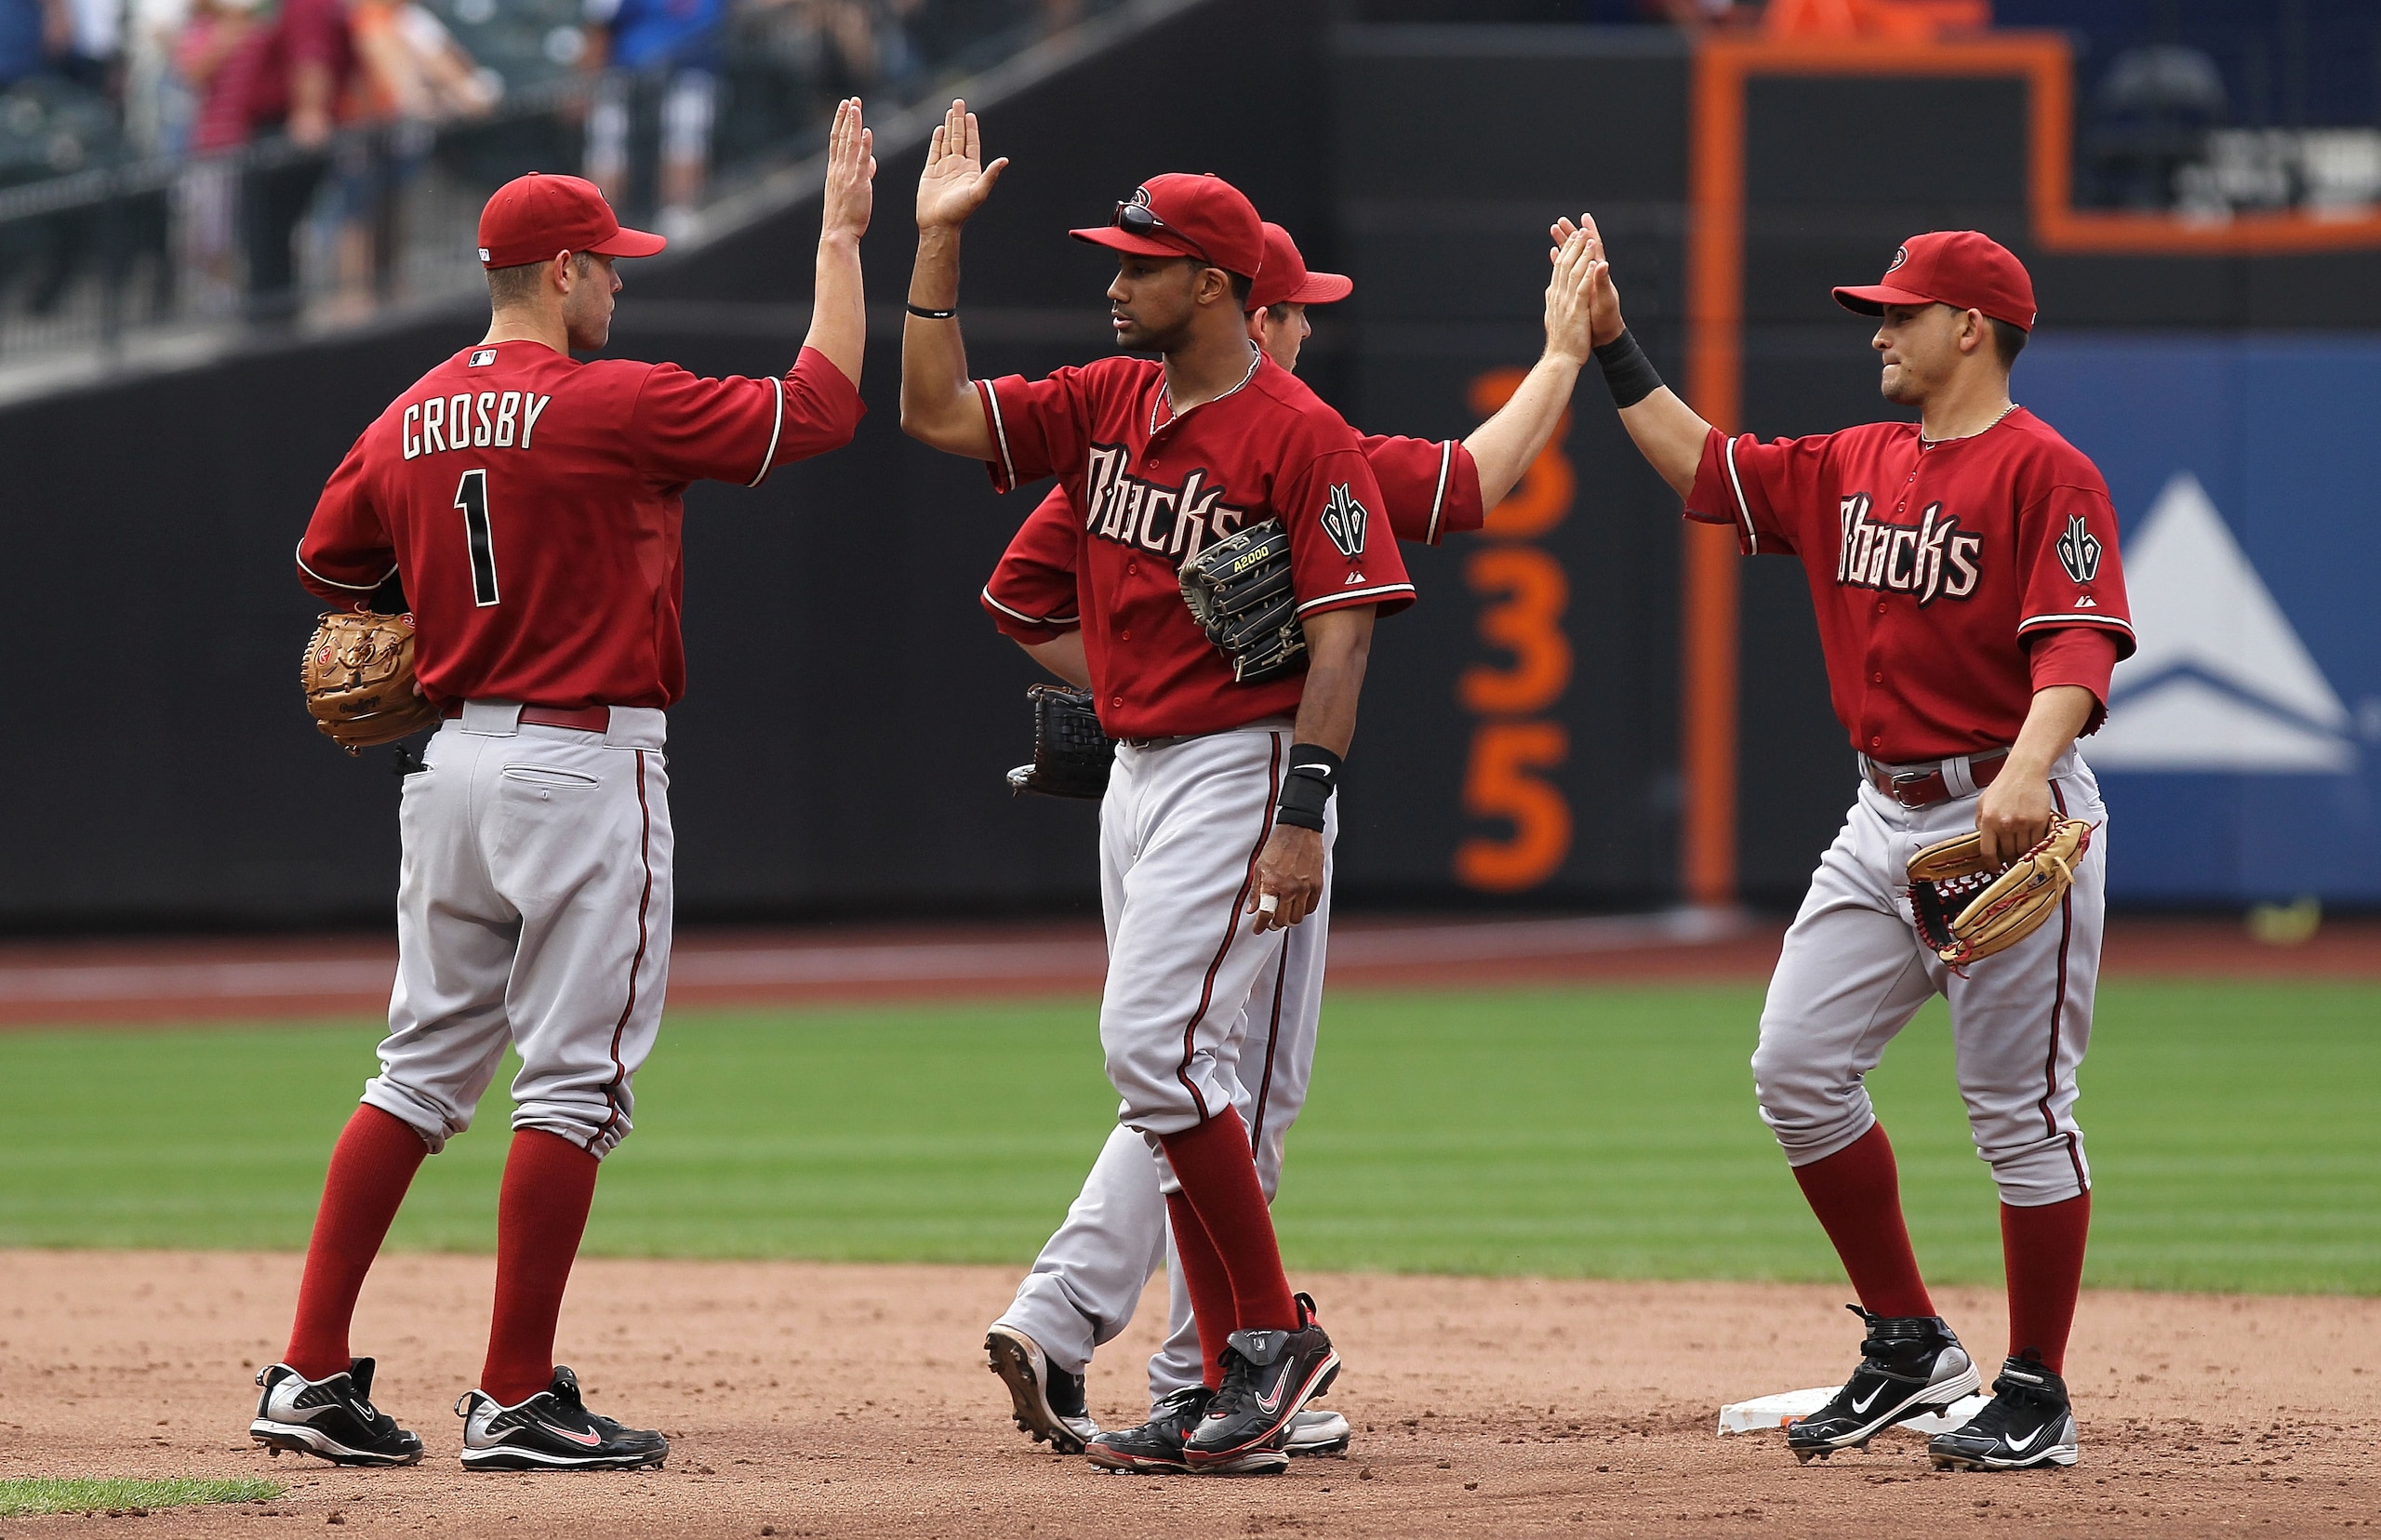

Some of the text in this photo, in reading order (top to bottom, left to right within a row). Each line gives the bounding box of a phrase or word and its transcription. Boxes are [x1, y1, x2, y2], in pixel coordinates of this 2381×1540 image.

[402, 391, 551, 460] CROSBY
[453, 468, 500, 607] 1
[1233, 545, 1270, 573] A2000
